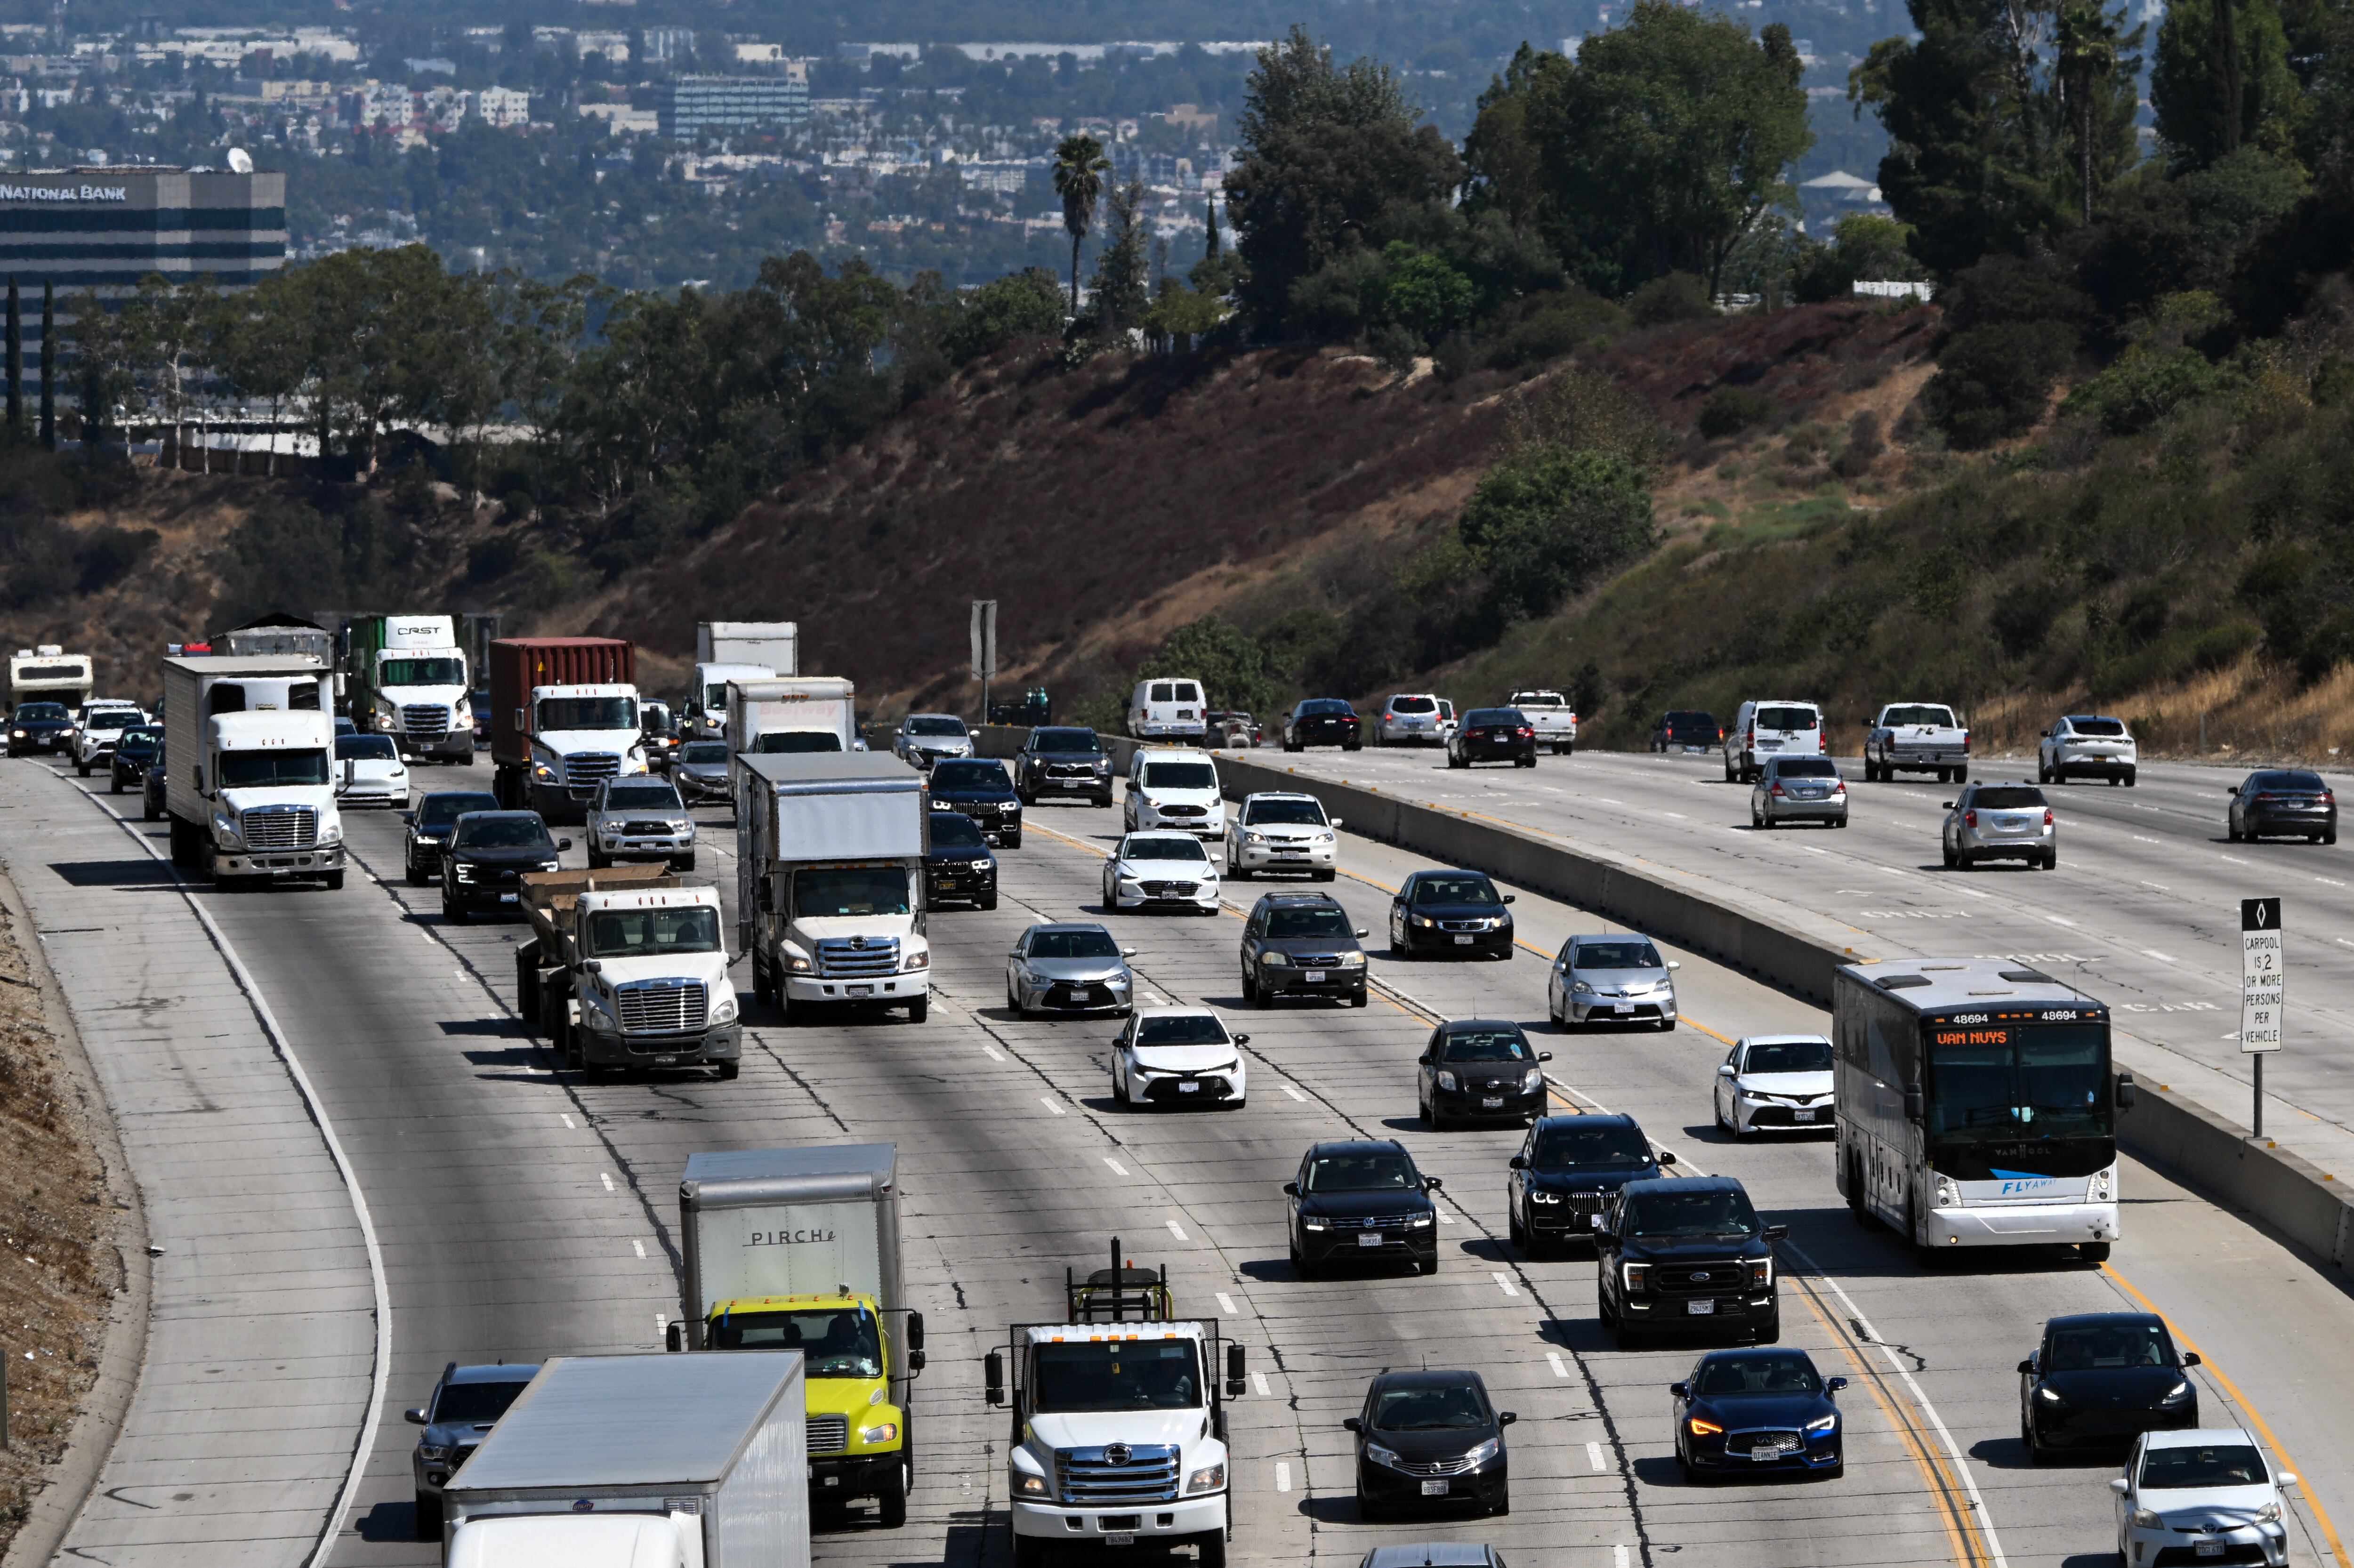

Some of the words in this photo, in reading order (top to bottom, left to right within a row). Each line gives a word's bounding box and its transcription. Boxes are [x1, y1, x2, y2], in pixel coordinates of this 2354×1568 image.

[0, 184, 77, 200] NATIONAL
[80, 184, 126, 200] BANK
[398, 627, 441, 635] CRST
[2245, 937, 2279, 950] CARPOOL
[2254, 957, 2261, 968] IS
[2265, 954, 2272, 970] 2
[2246, 976, 2257, 988] OR
[2260, 974, 2281, 987] MORE
[2246, 993, 2280, 1006] PERSONS
[1953, 1014, 1988, 1024] 48694
[2041, 1011, 2077, 1021] 48694
[2255, 1012, 2269, 1024] PER
[1937, 1033, 1966, 1045] VAN
[1970, 1031, 2007, 1044] NUYS
[2245, 1029, 2278, 1043] VEHICLE
[2002, 1179, 2057, 1195] FLYAWAY
